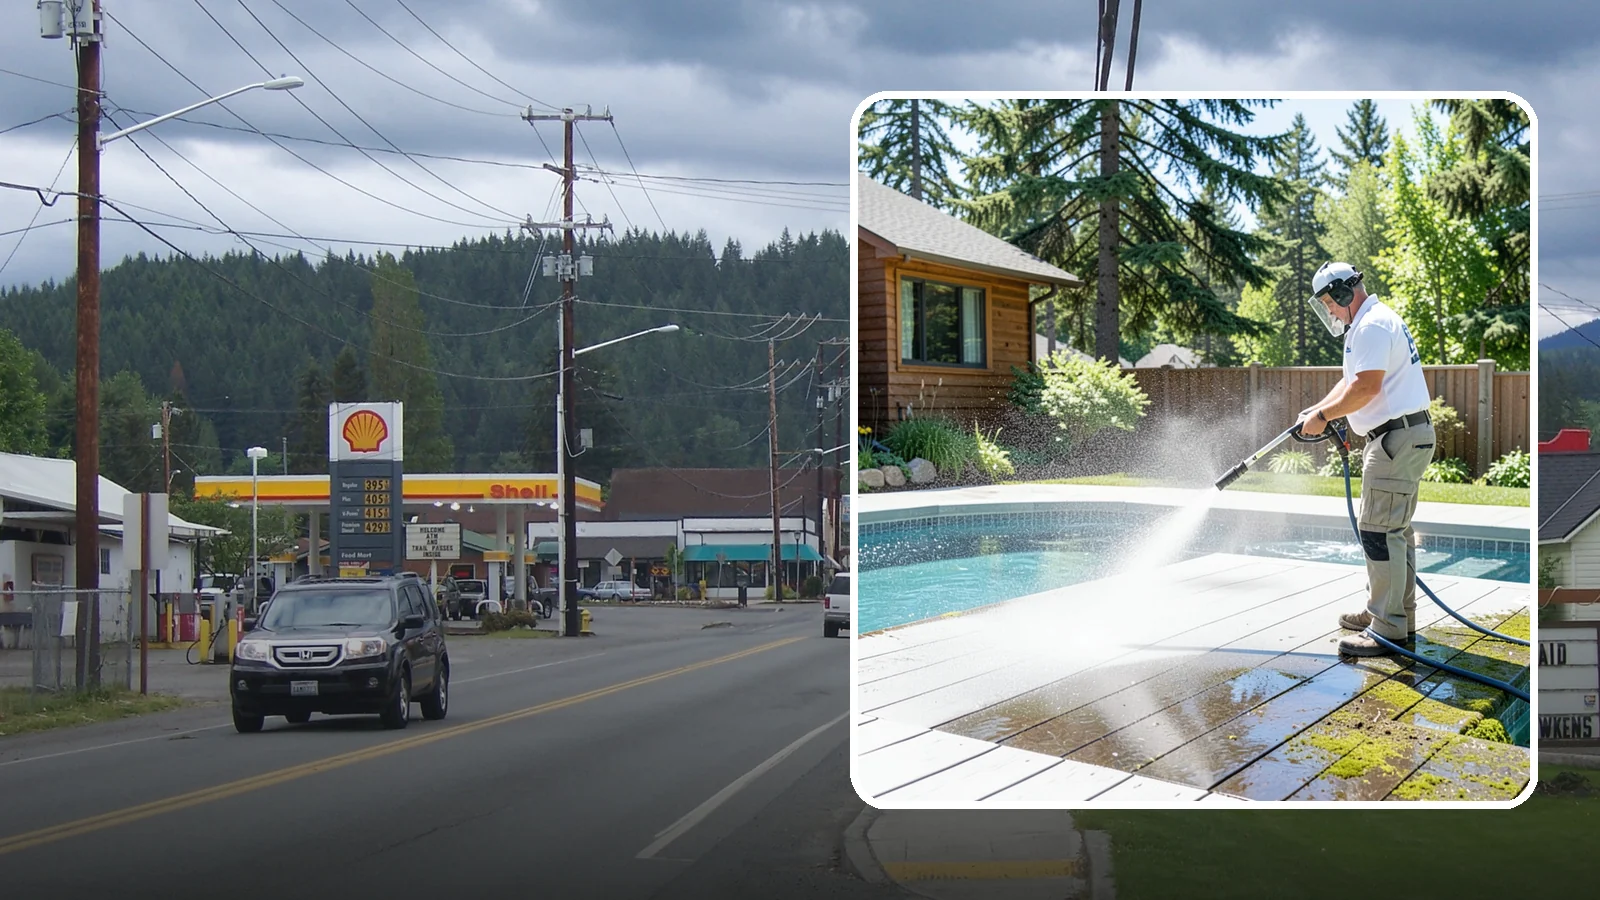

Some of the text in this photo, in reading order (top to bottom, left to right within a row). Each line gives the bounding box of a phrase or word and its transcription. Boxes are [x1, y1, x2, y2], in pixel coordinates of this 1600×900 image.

[366, 480, 384, 490] 395
[490, 484, 547, 498] Shell
[366, 494, 384, 504] 405
[366, 508, 384, 518] 415
[366, 522, 384, 532] 429
